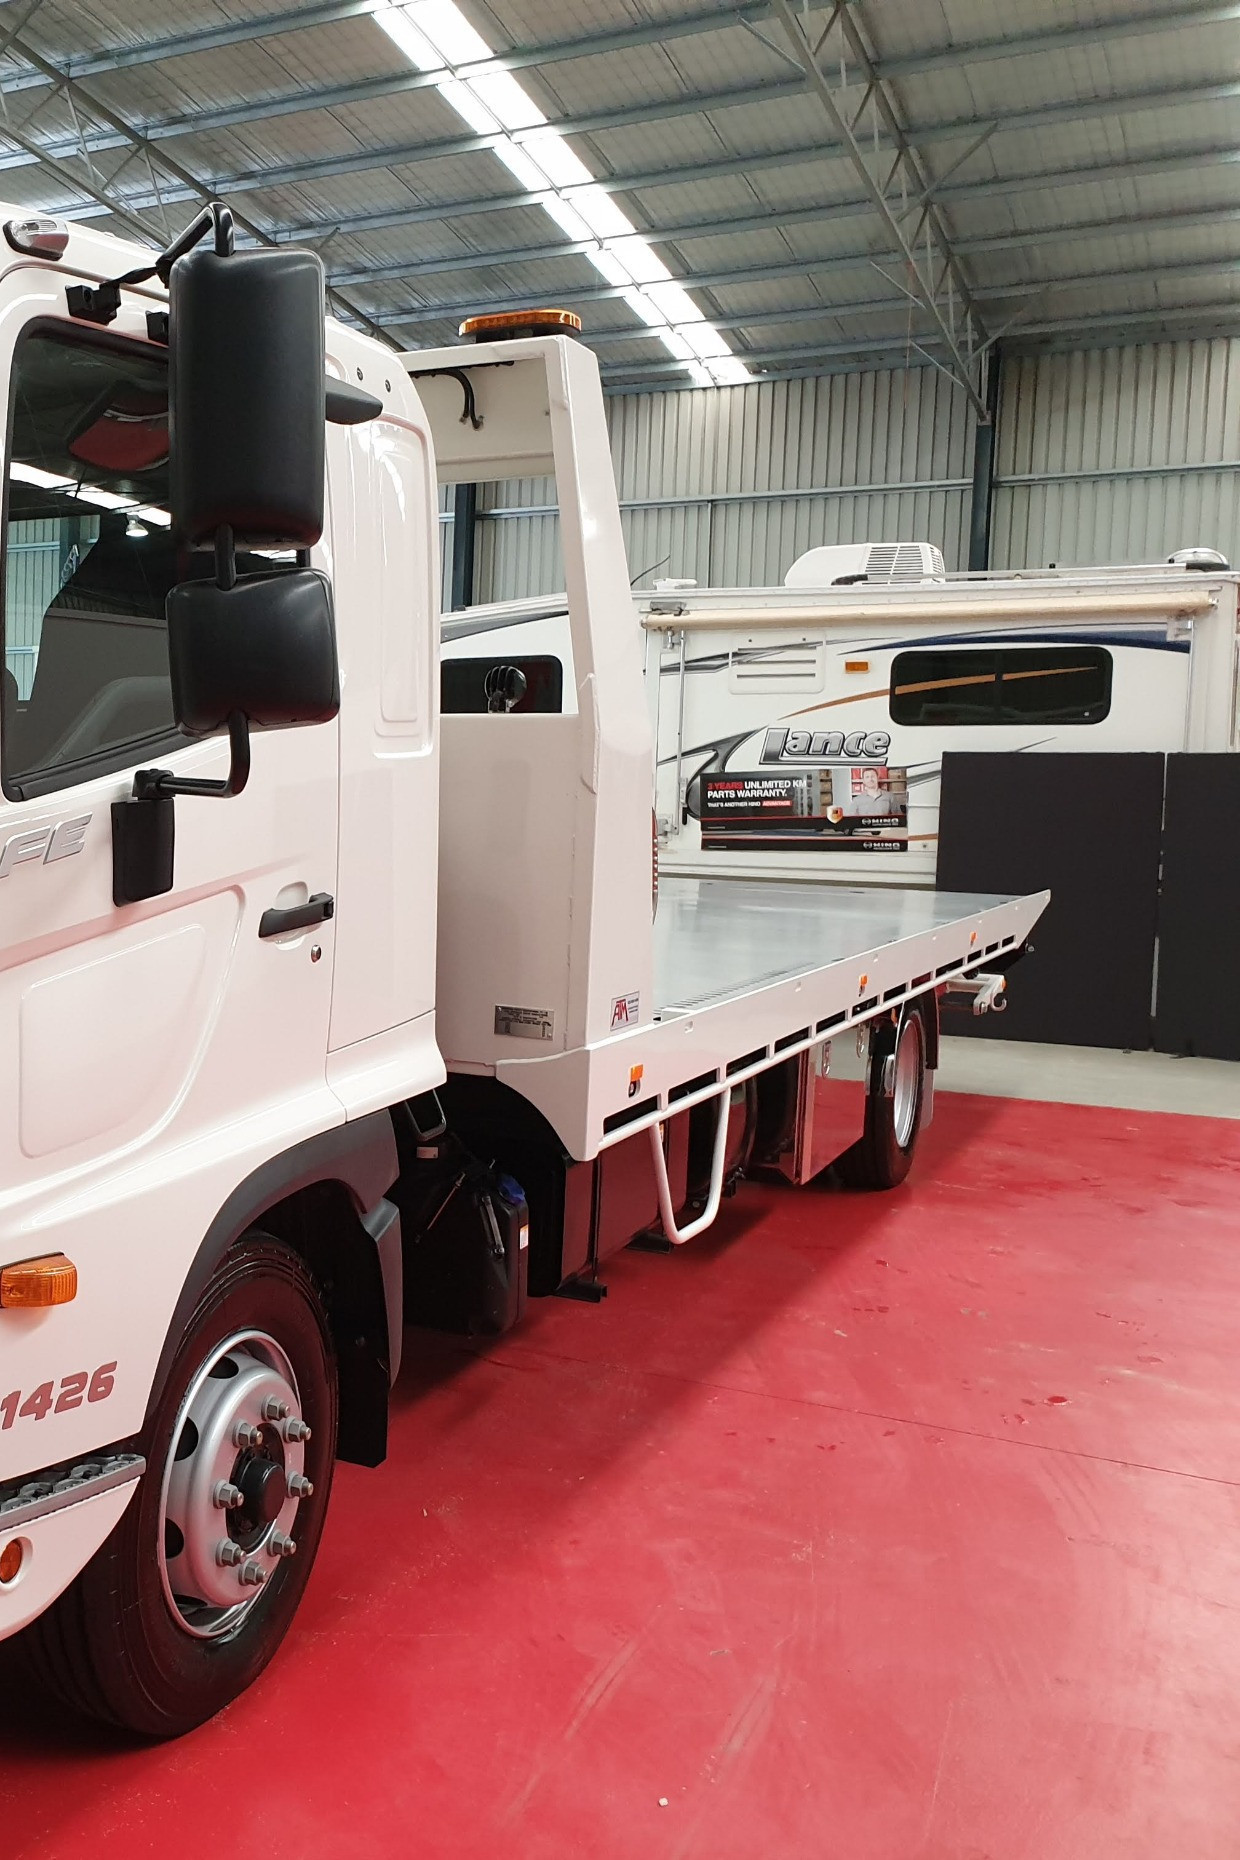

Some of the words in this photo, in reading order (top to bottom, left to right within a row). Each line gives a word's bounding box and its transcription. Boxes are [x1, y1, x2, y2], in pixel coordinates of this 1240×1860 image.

[759, 727, 891, 765] Lance
[707, 790, 736, 799] PARTS
[737, 788, 787, 798] WARRANTY.
[715, 782, 744, 790] YEARS
[744, 780, 791, 789] UNLIMITED
[792, 780, 807, 788] KM
[0, 1360, 117, 1430] 1426
